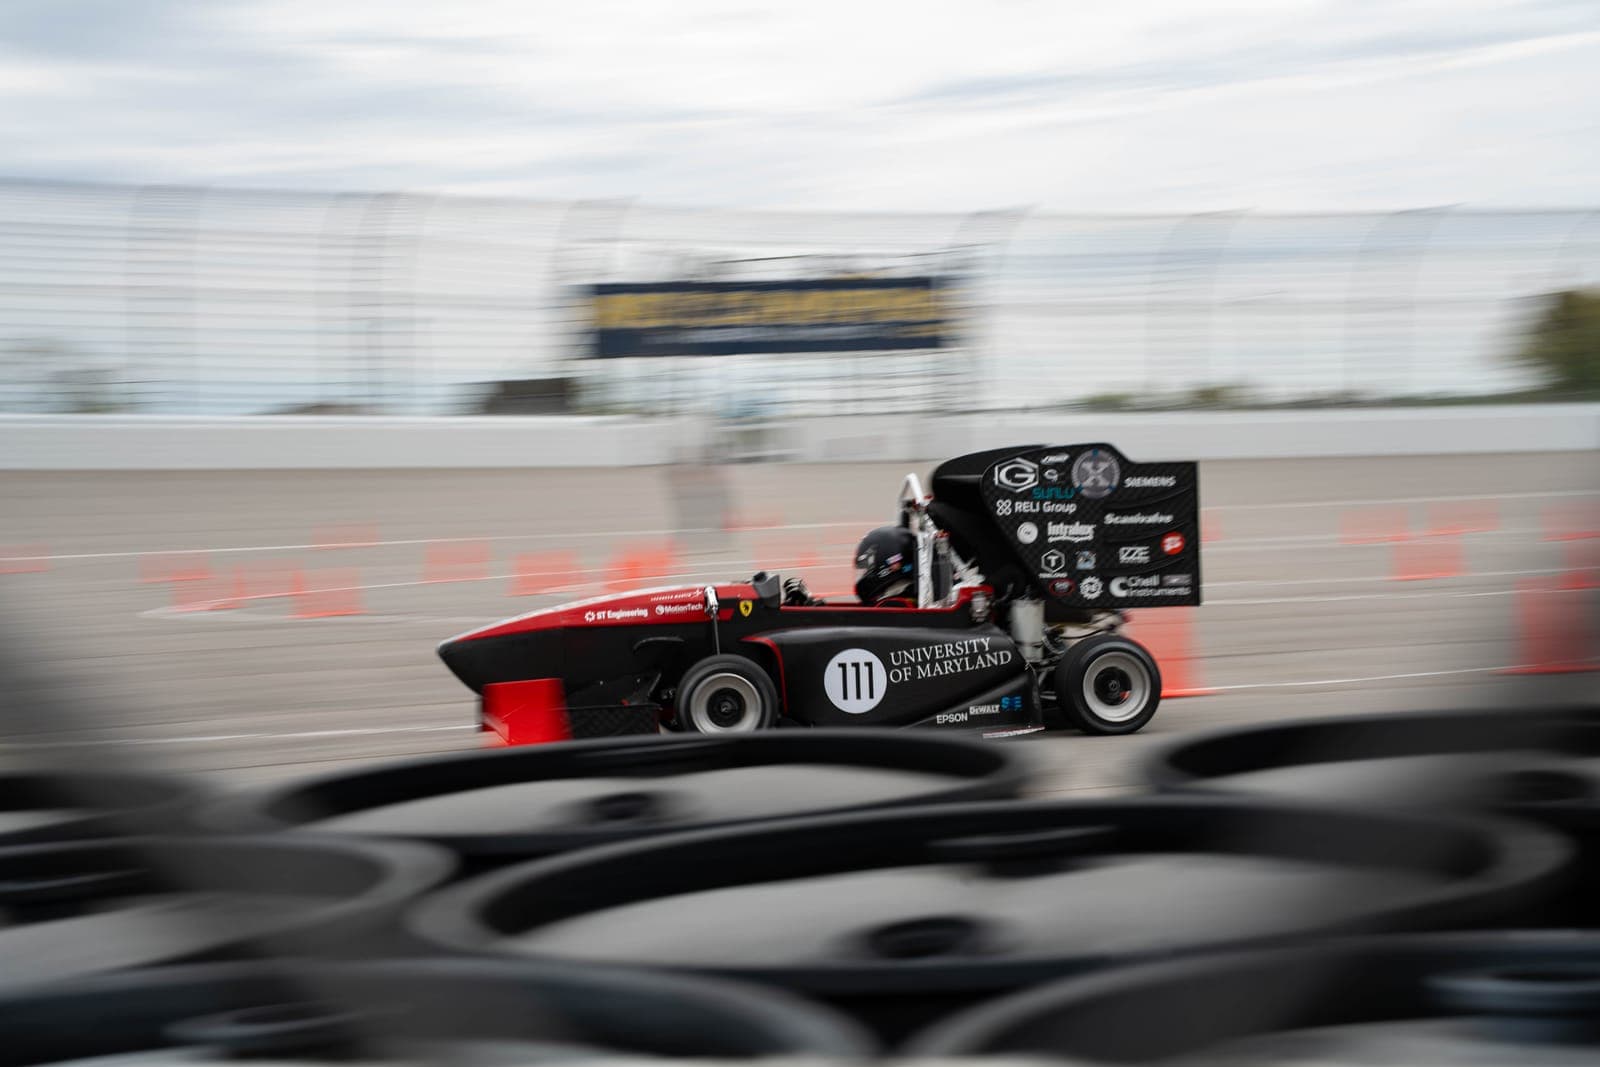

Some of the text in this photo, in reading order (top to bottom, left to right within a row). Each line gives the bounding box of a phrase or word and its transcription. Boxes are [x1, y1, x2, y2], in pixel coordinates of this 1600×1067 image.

[1124, 475, 1176, 488] SIEMENS
[1014, 501, 1077, 515] RELI Group
[596, 608, 648, 620] ST Engineering
[890, 637, 991, 667] UNIVERSITY
[889, 650, 1012, 683] OF MARYLAND
[838, 661, 875, 700] 111
[936, 712, 968, 724] EPSON
